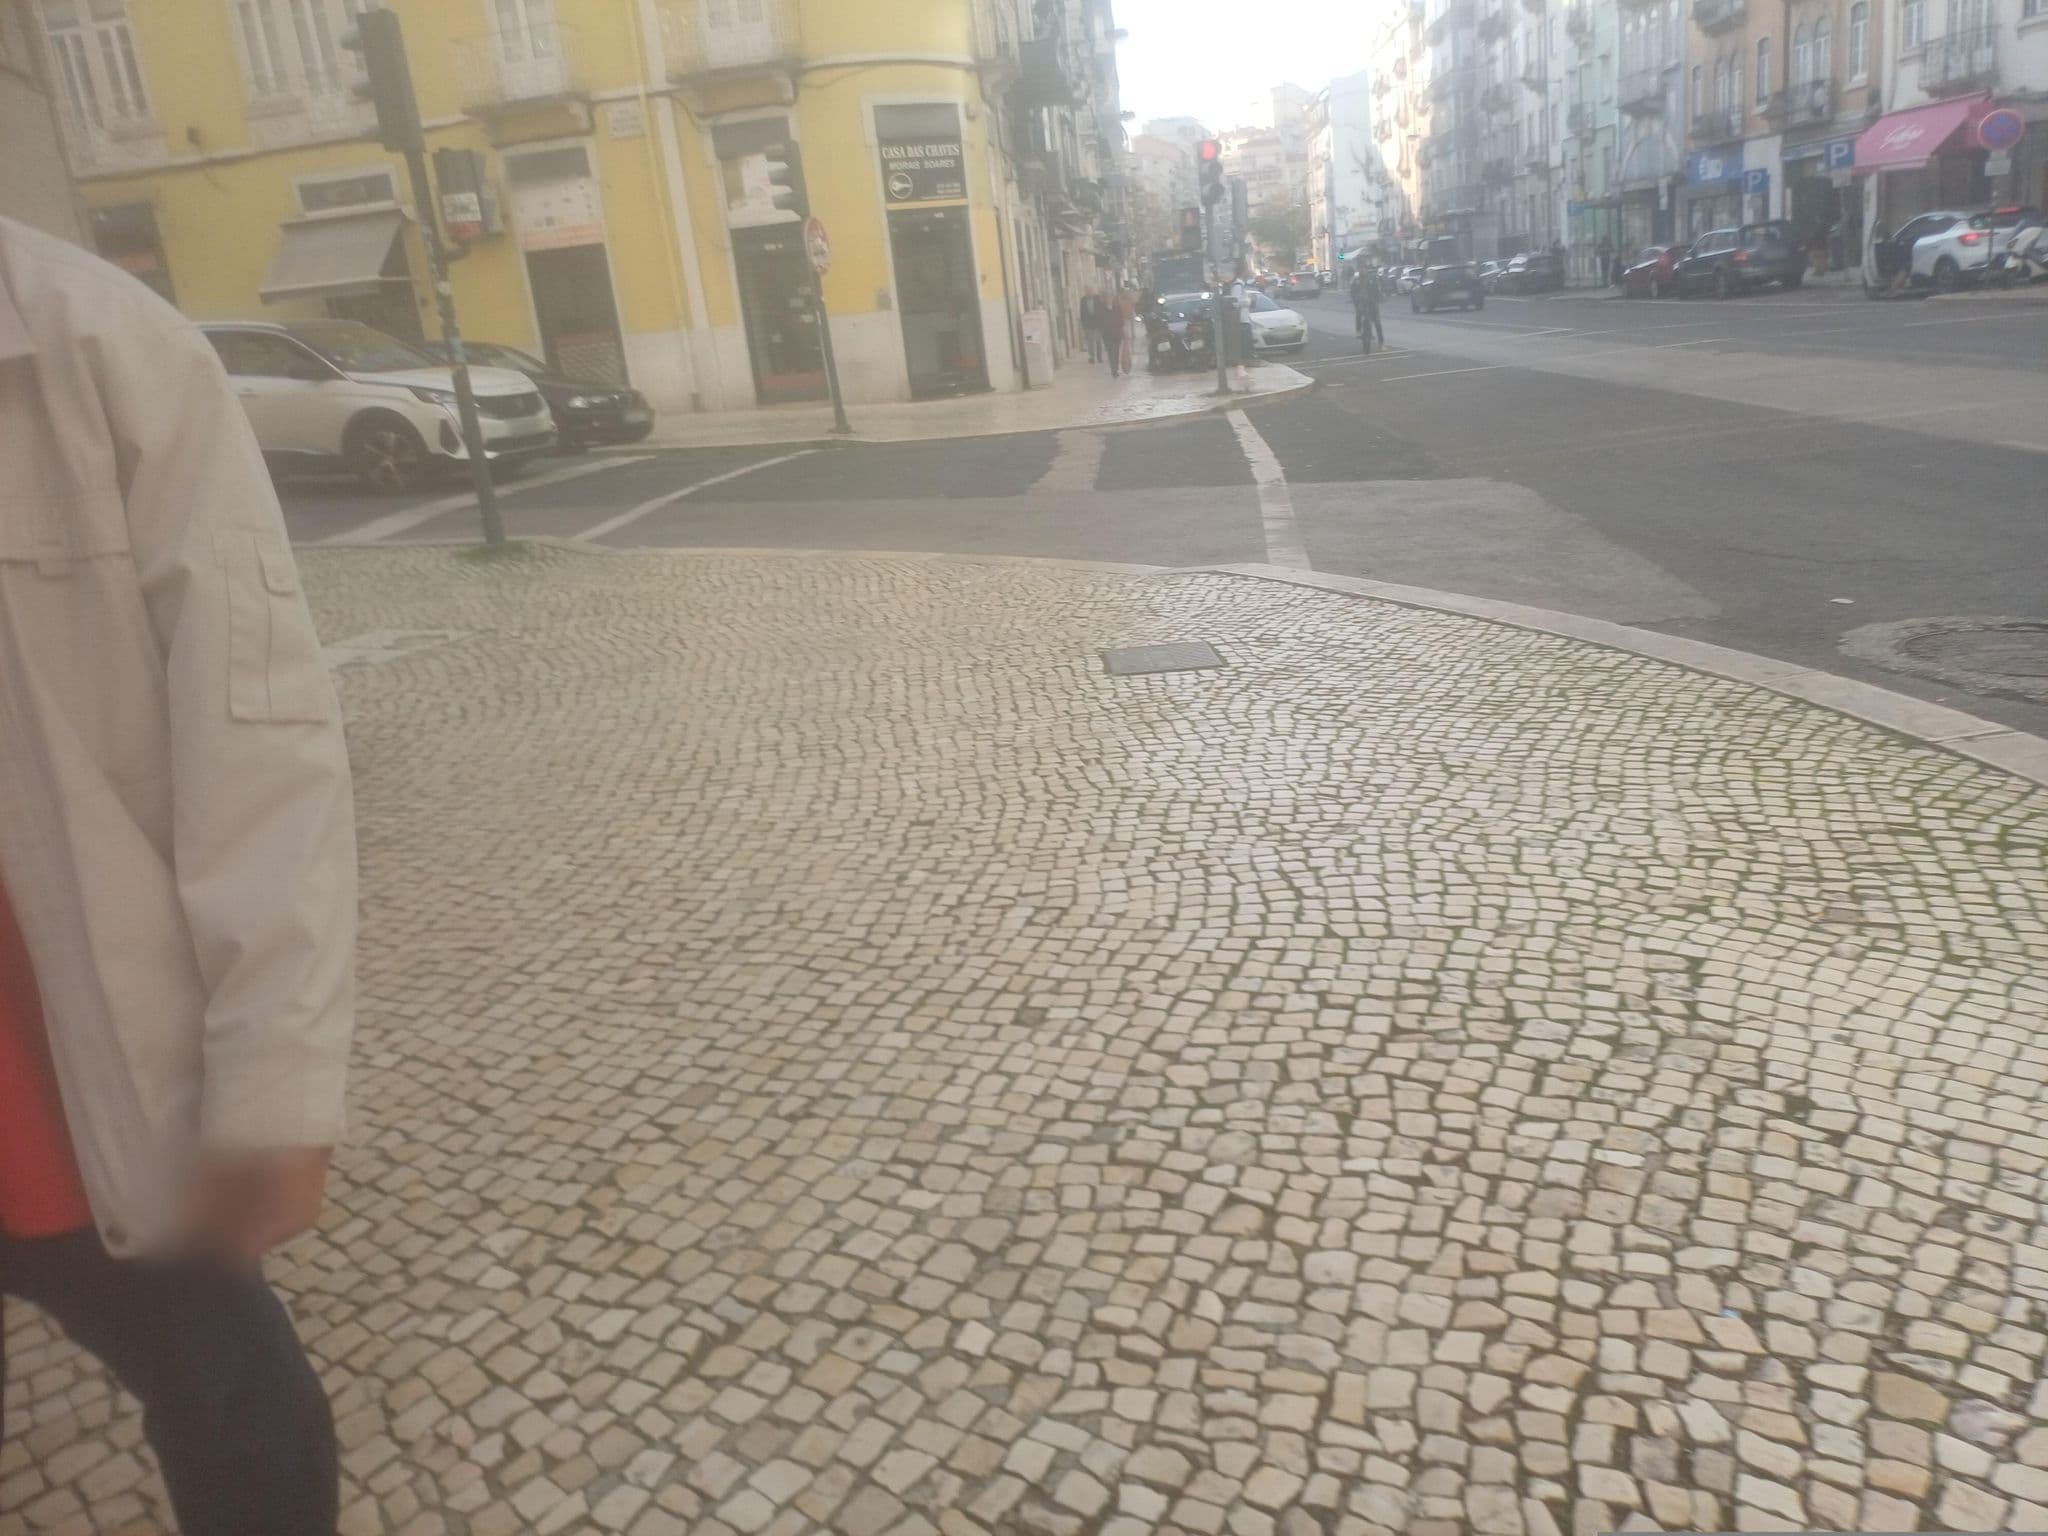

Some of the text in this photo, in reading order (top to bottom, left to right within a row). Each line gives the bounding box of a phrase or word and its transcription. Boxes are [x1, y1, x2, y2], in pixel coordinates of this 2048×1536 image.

[882, 144, 960, 159] CASA DAS CHAVES
[1830, 143, 1849, 167] P
[1748, 171, 1762, 192] P
